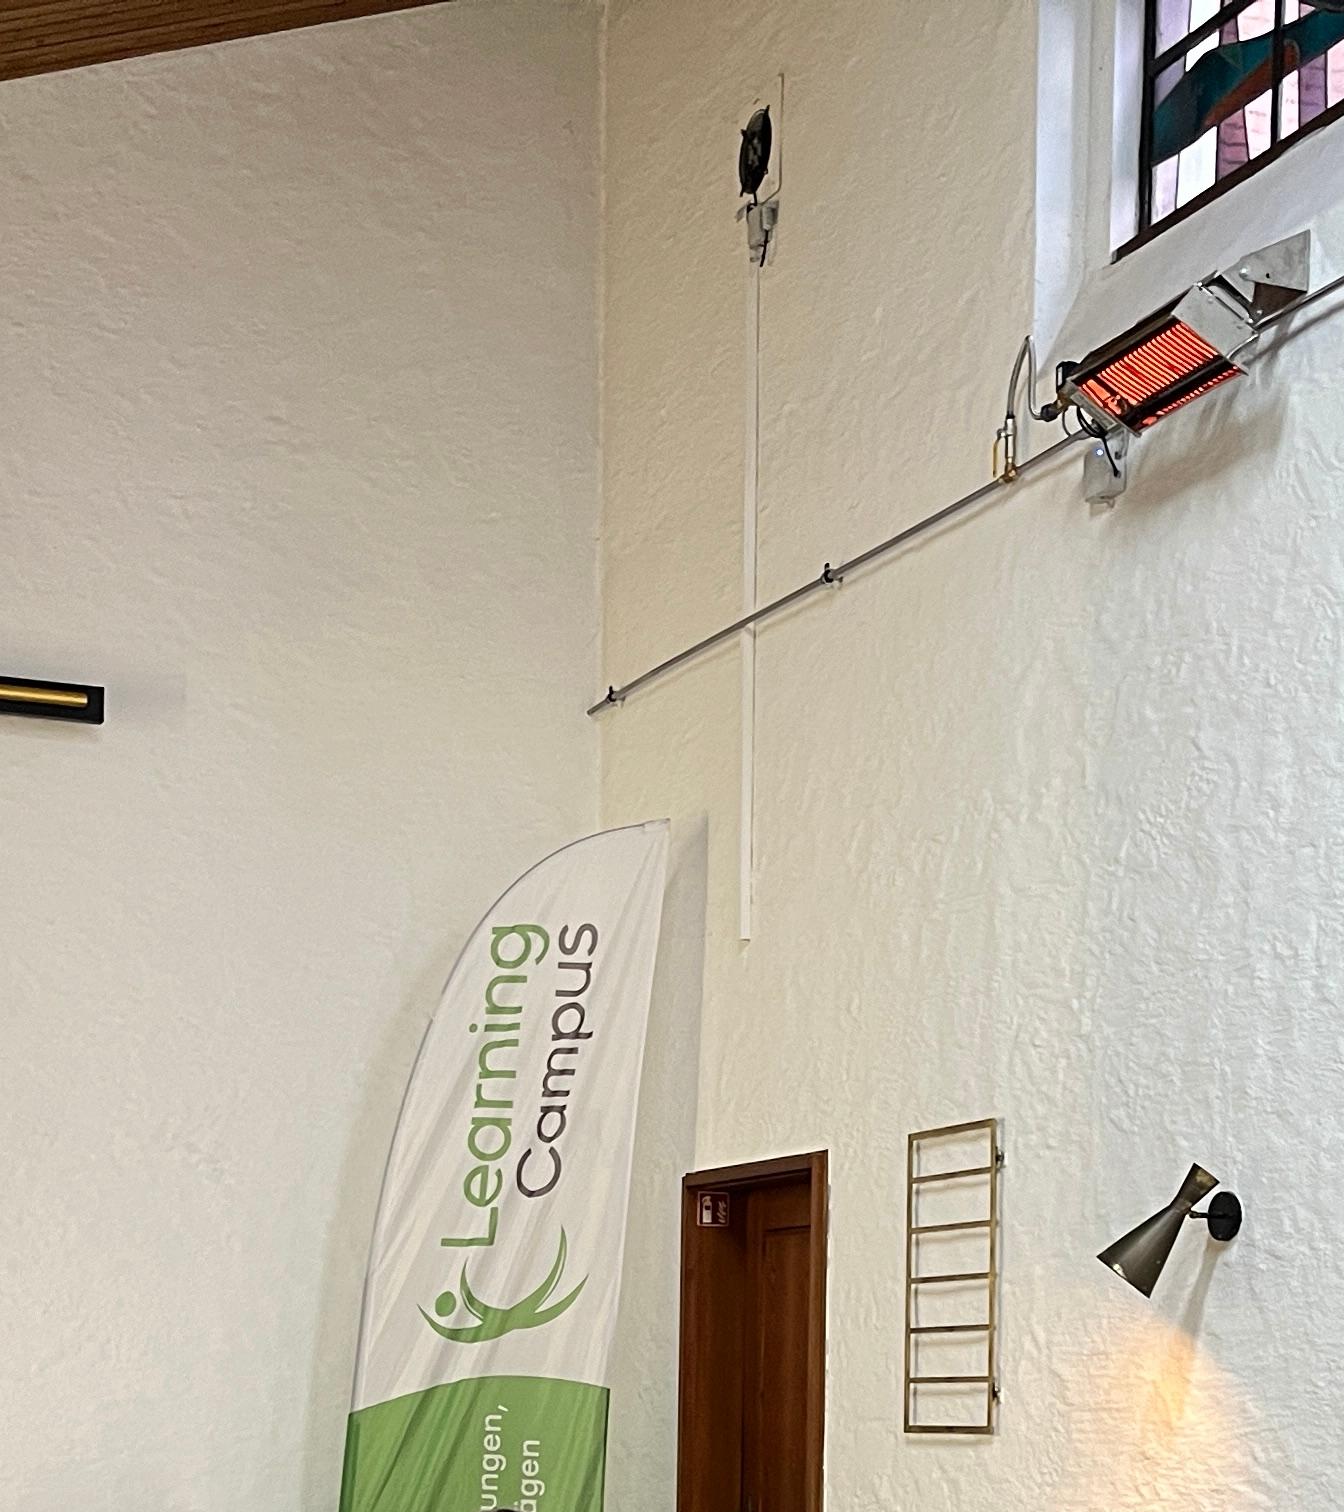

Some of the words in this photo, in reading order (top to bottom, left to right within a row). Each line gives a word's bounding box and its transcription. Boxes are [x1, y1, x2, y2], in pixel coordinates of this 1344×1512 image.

[440, 923, 550, 1247] Learning
[516, 922, 599, 1198] Campus
[480, 1404, 509, 1511] ungen,
